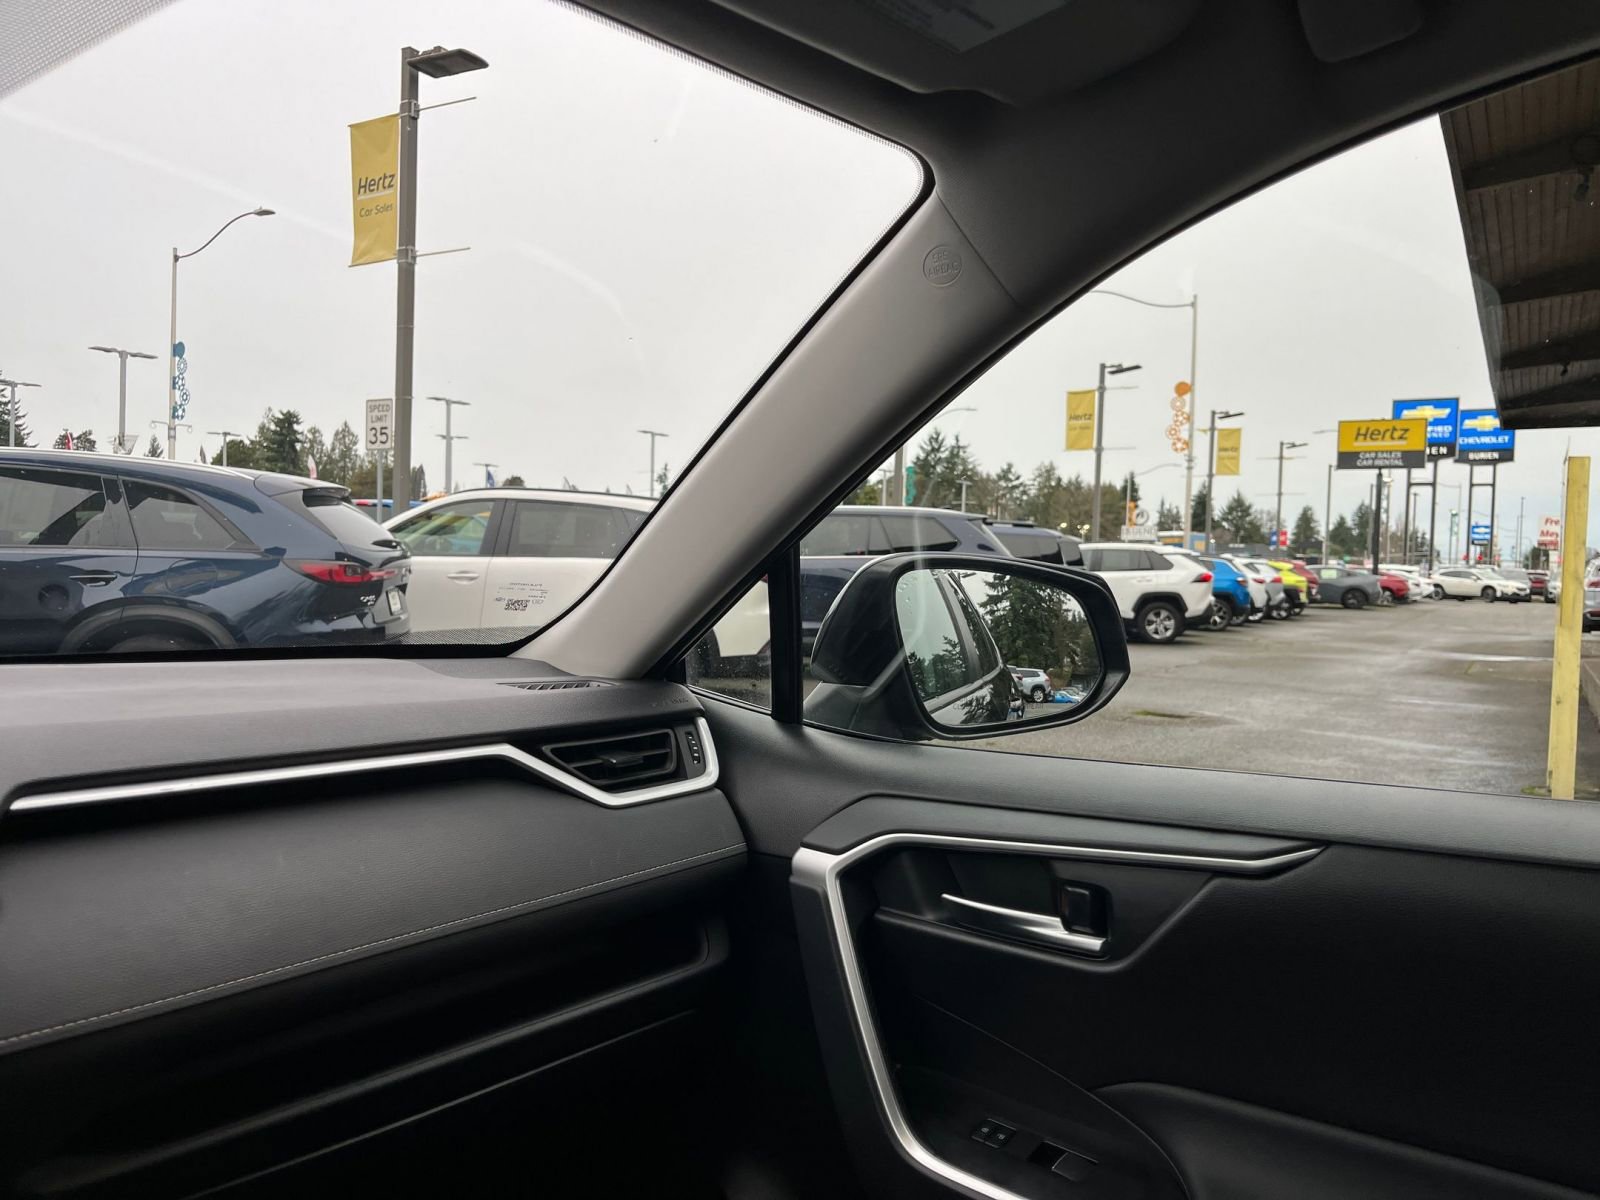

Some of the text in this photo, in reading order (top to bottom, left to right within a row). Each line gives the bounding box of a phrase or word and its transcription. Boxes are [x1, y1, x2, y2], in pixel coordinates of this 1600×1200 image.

[357, 172, 396, 195] Hertz
[359, 203, 394, 218] Car Sales
[368, 404, 391, 413] SPEED
[370, 414, 388, 424] LIMIT
[1354, 425, 1411, 441] Hertz
[1427, 425, 1453, 433] FIED
[369, 426, 389, 445] 35
[1459, 435, 1510, 445] CHEVROLET
[1359, 450, 1402, 459] CAR SALES
[1426, 446, 1448, 455] IEN
[1468, 451, 1499, 460] BURIEN
[1356, 458, 1404, 467] CAR RENTAL
[1544, 516, 1560, 526] Fre
